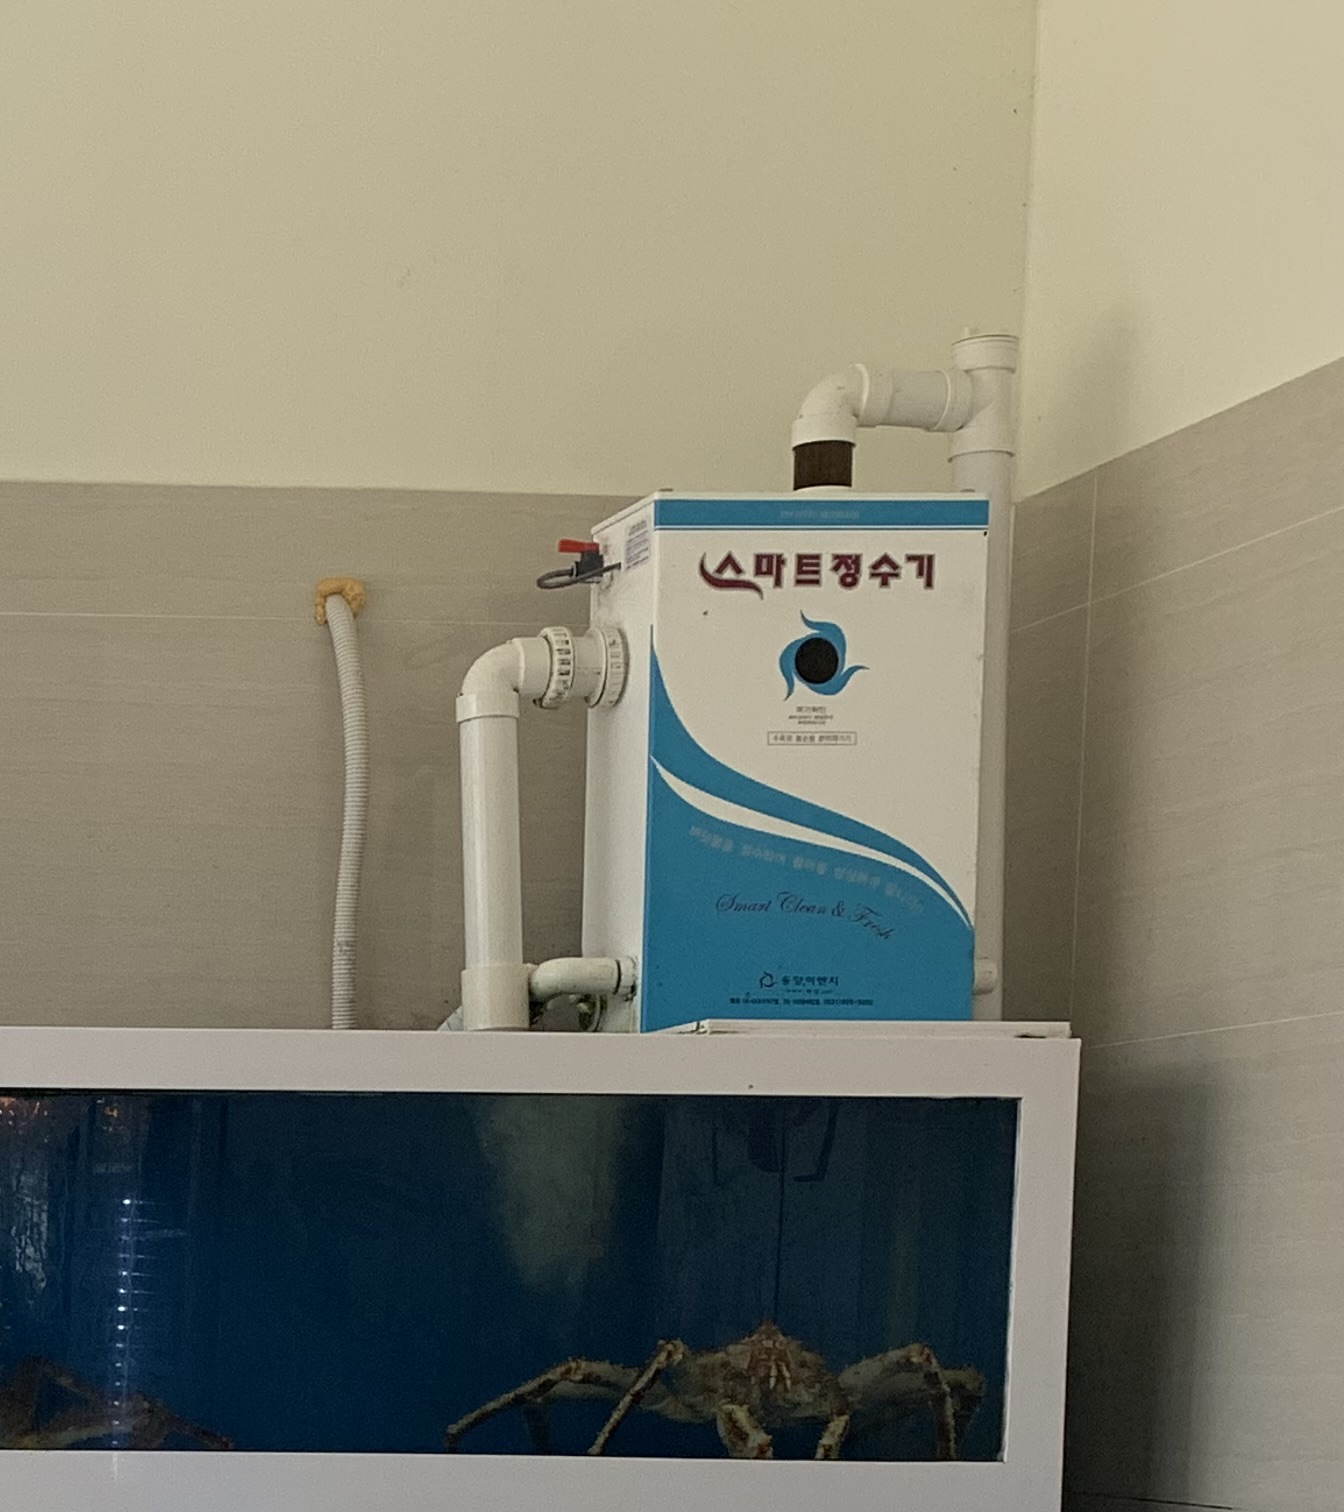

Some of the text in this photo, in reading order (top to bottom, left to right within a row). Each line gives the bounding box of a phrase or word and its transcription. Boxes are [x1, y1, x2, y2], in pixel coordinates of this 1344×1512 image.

[700, 551, 935, 599] 스마트정수기
[715, 891, 896, 940] Smart Clean & Fresh
